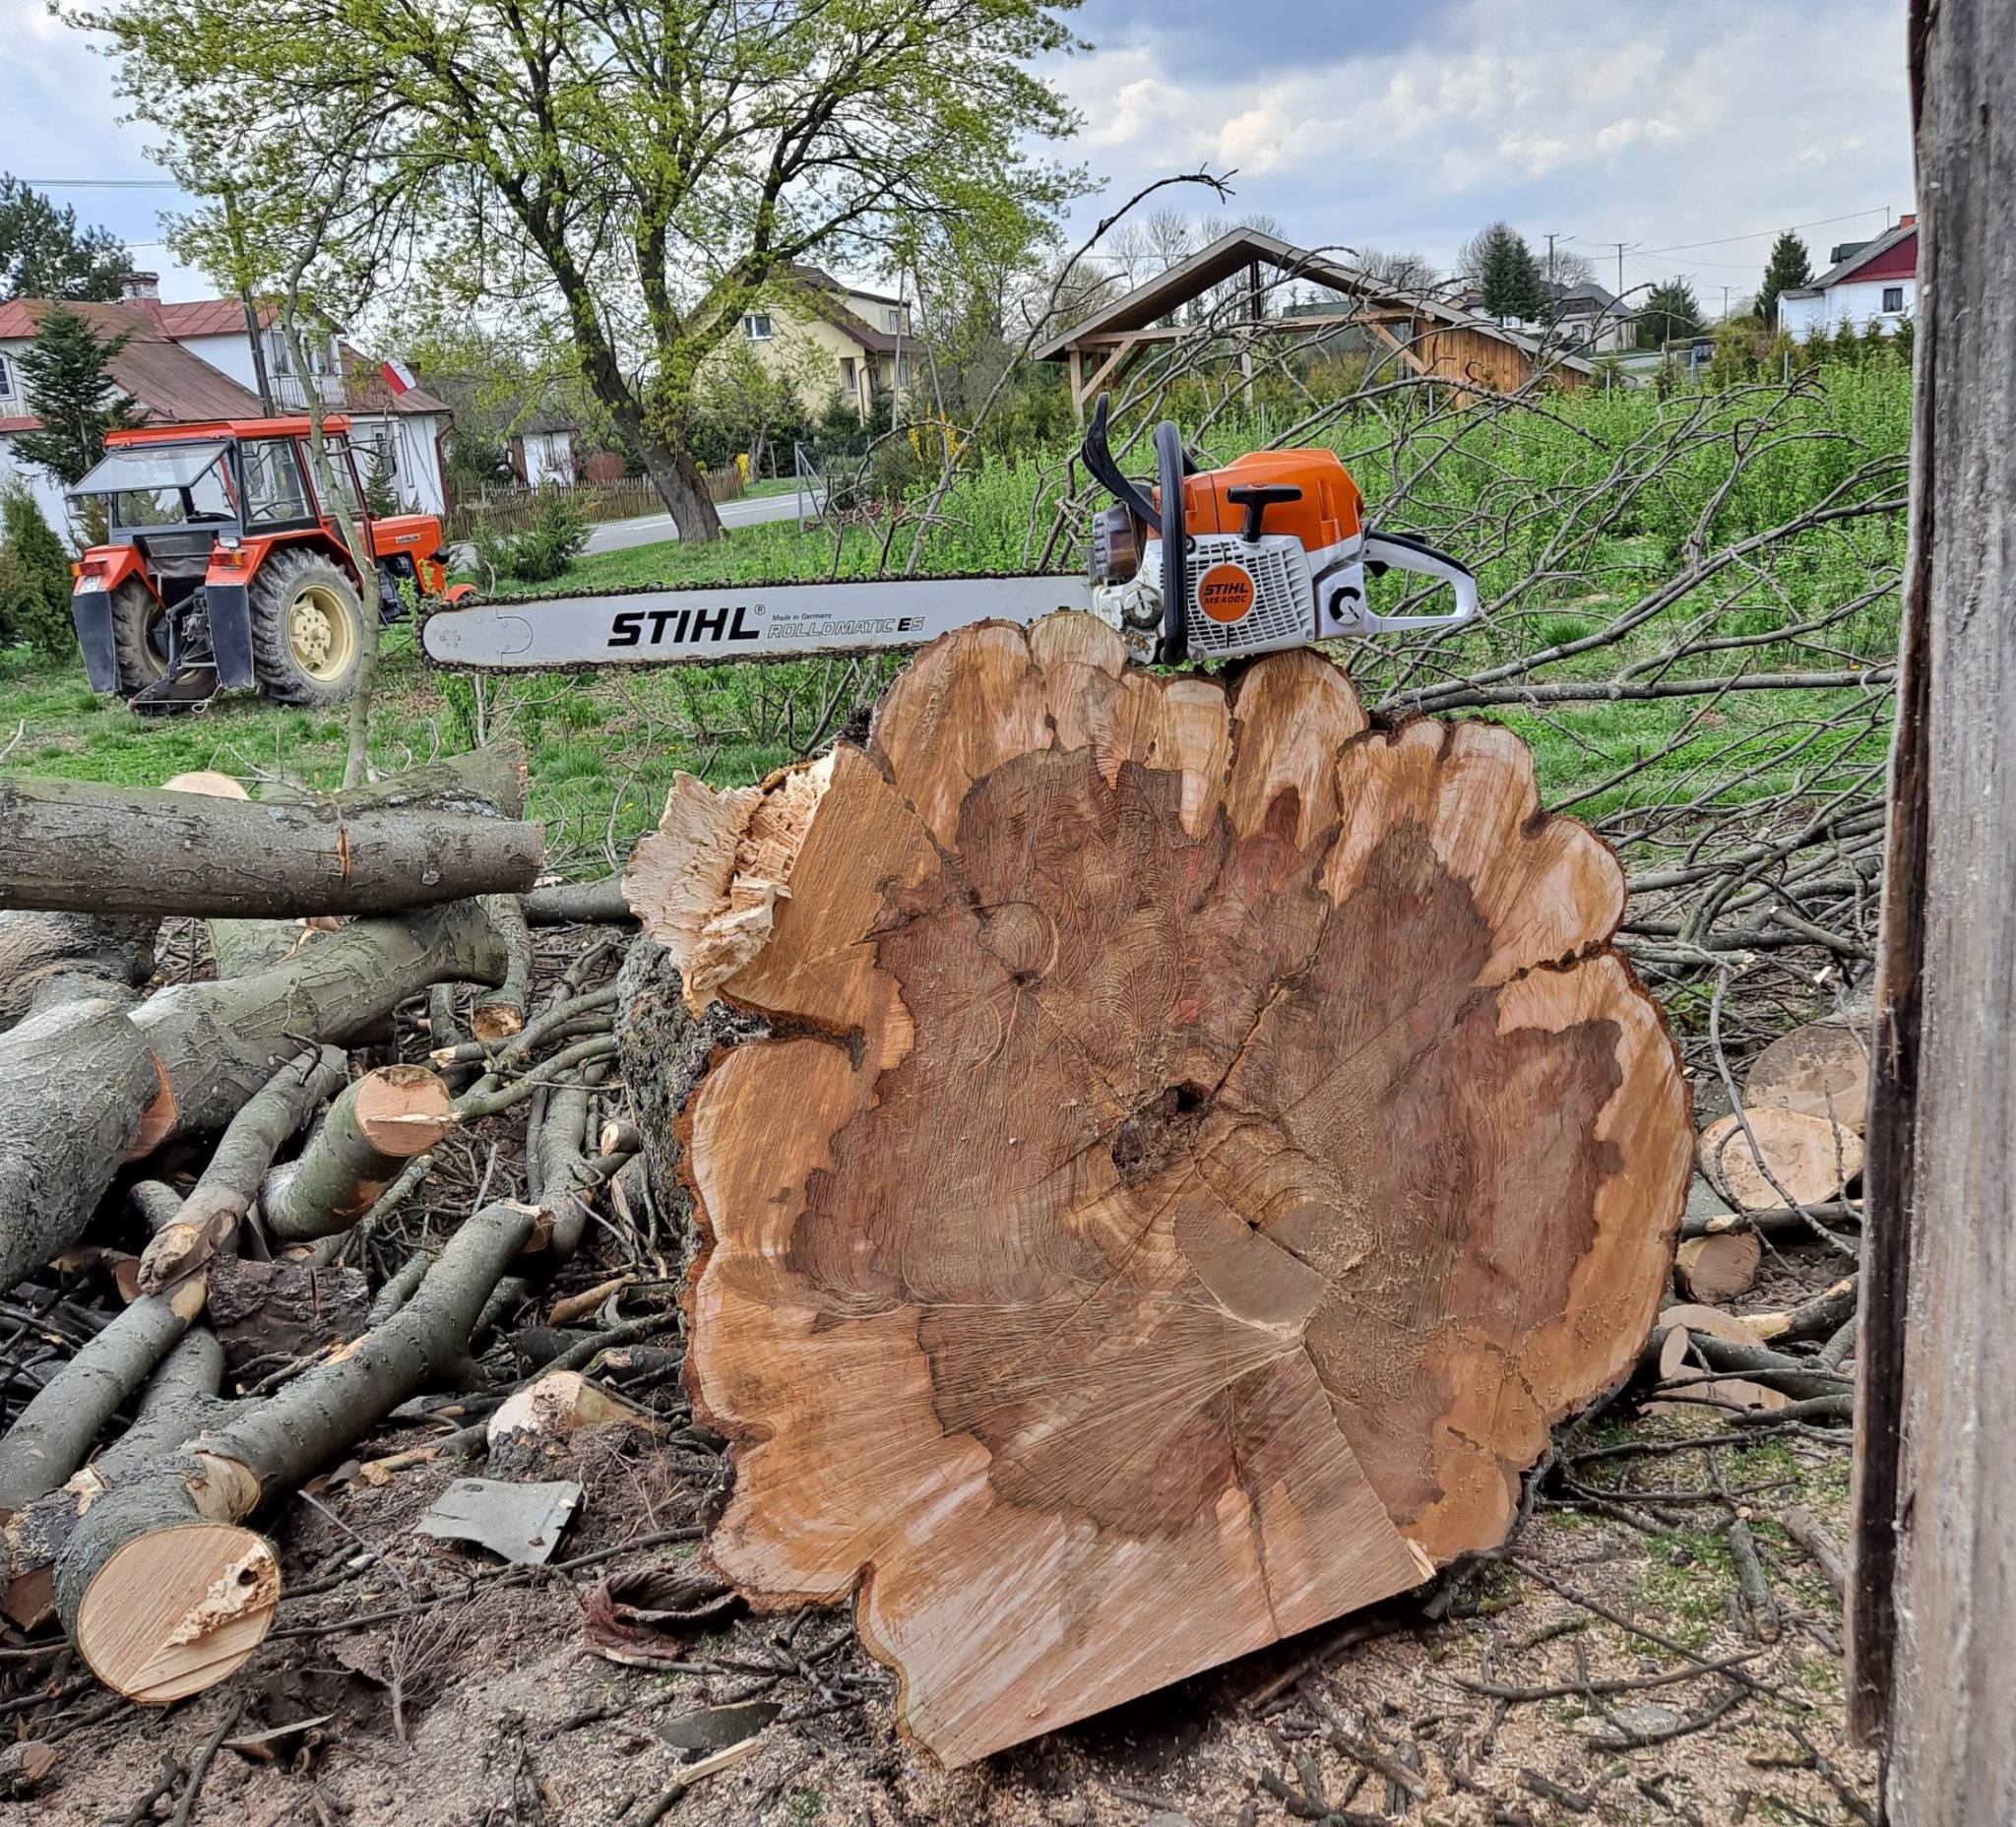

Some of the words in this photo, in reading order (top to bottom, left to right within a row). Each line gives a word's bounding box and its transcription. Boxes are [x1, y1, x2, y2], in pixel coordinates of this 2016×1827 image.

[1204, 582, 1249, 596] STIHL
[607, 606, 760, 647] STIHL
[767, 618, 895, 639] ROLLOMATIC
[897, 616, 925, 632] ES
